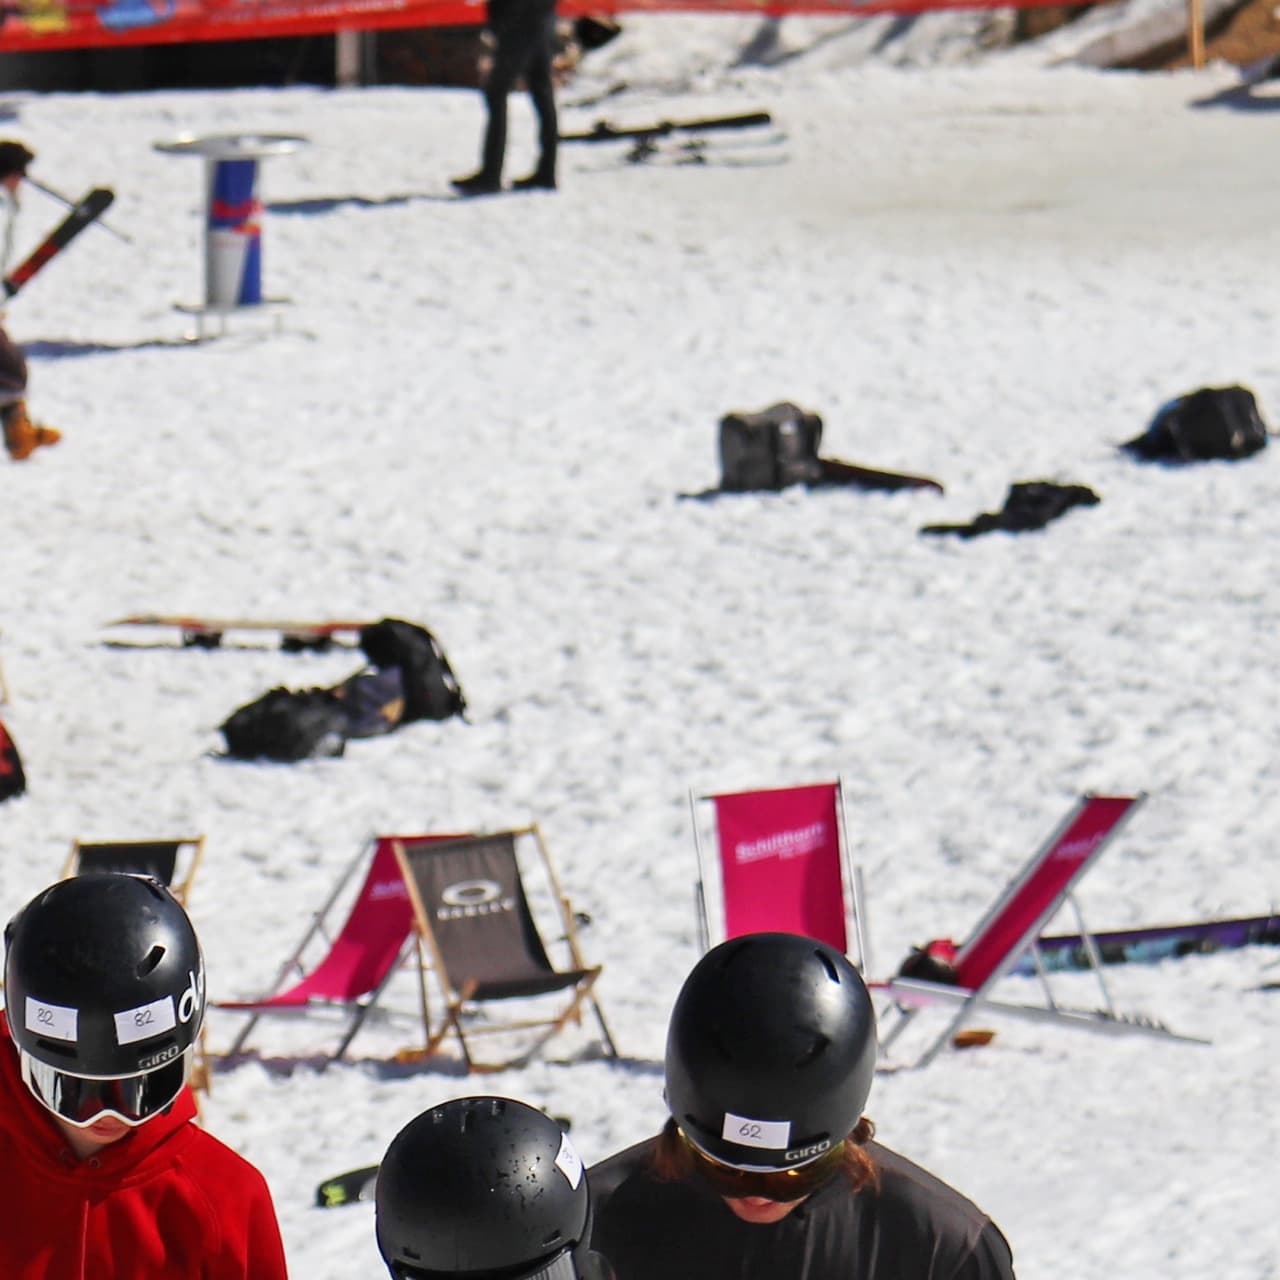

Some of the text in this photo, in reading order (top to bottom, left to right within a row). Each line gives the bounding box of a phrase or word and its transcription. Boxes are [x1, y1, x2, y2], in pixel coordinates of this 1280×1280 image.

[134, 1009, 156, 1028] 82
[138, 1045, 180, 1070] GIRO
[739, 1123, 763, 1140] 62
[784, 1140, 832, 1161] GIRO
